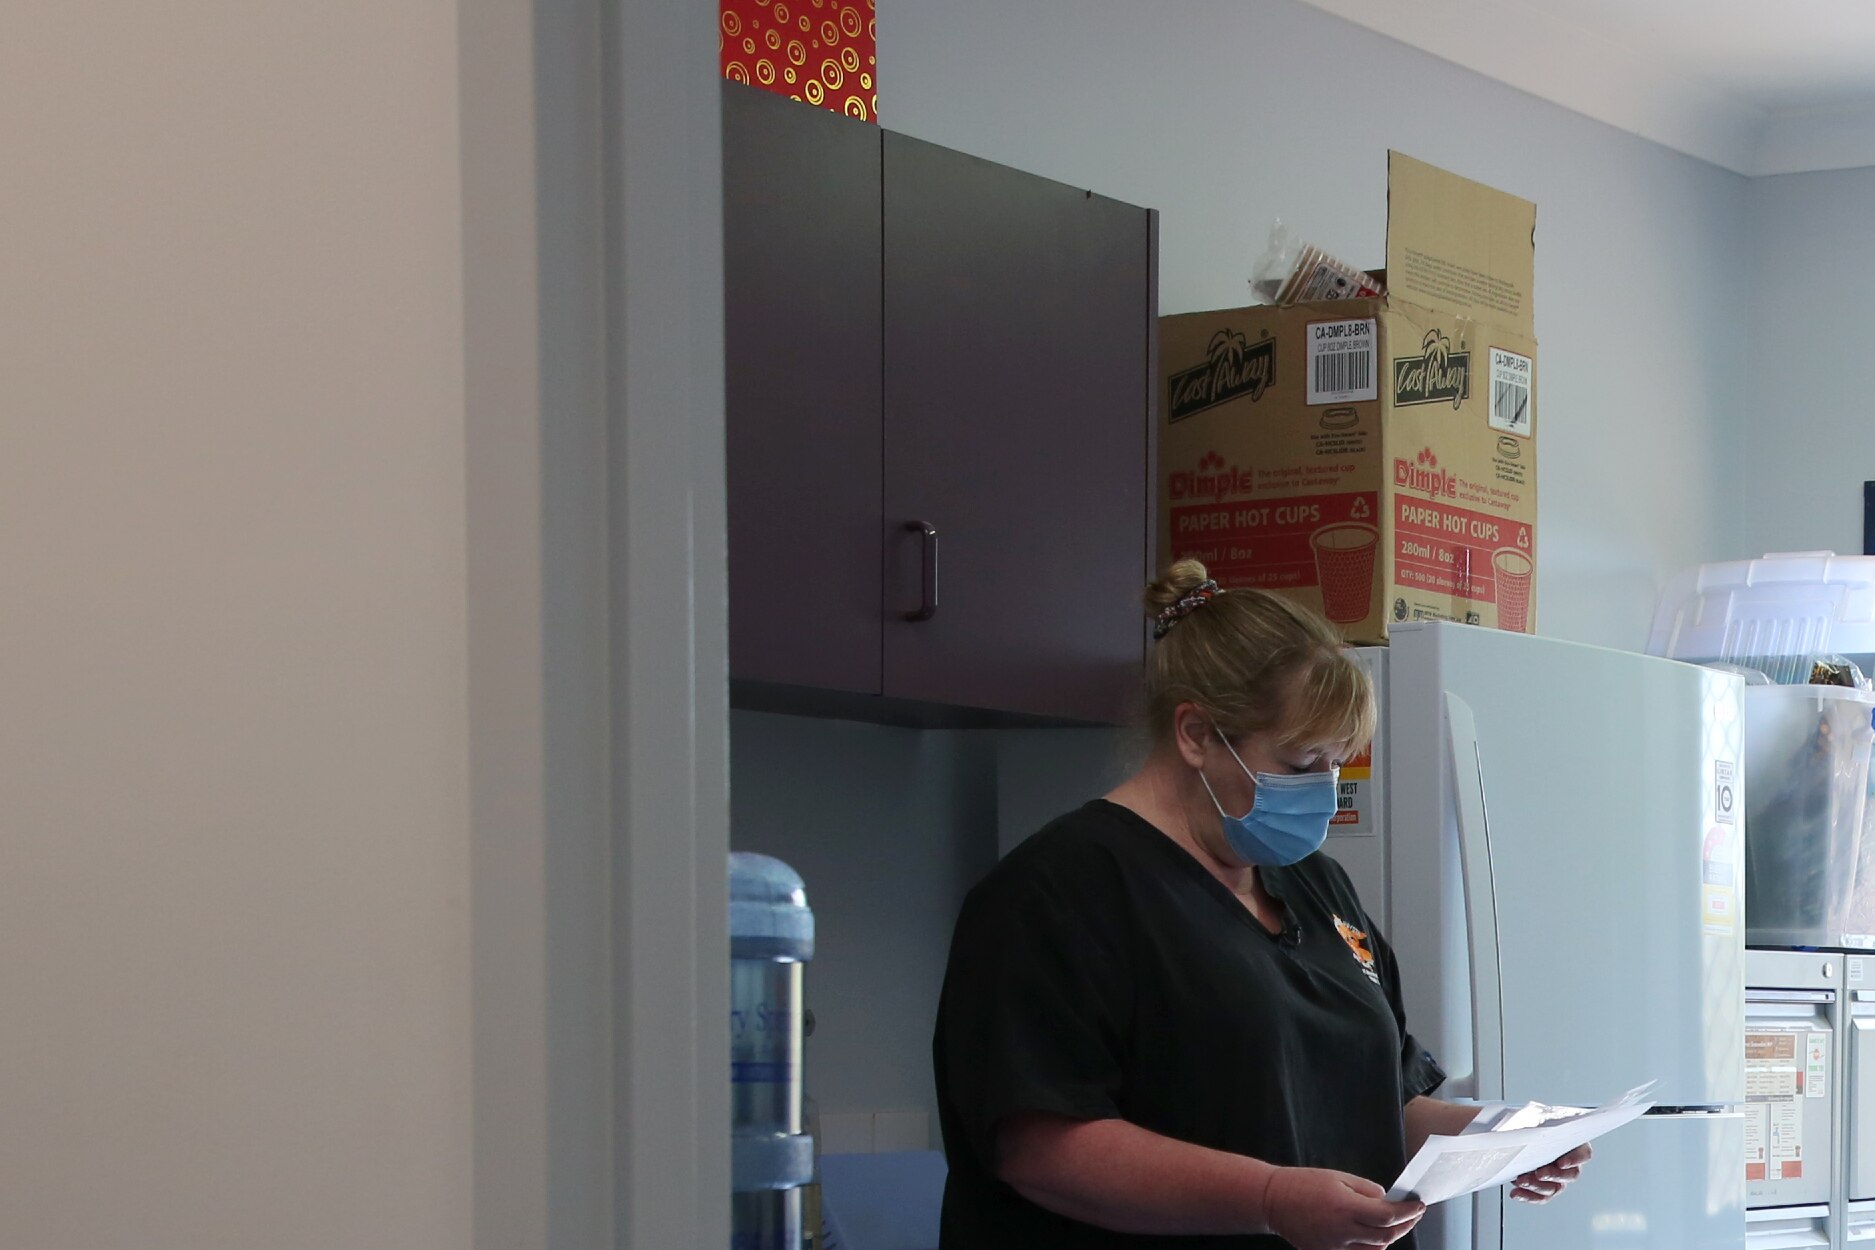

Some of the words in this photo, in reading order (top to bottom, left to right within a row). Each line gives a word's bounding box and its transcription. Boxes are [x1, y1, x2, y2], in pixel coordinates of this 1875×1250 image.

[1315, 322, 1370, 340] CA-DMPL8-BRN
[1340, 465, 1355, 474] cup
[1394, 457, 1457, 499] Dimple
[1169, 466, 1254, 502] Dimple
[1292, 479, 1300, 487] to
[1179, 512, 1230, 532] PAPER
[1235, 508, 1270, 527] HOT
[1275, 505, 1320, 524] CUPS
[1402, 505, 1440, 529] PAPER
[1443, 513, 1467, 535] HOT
[1470, 520, 1499, 542] CUPS
[1401, 541, 1430, 558] 280ml
[1439, 549, 1454, 564] 8oz
[1340, 782, 1357, 795] WEST
